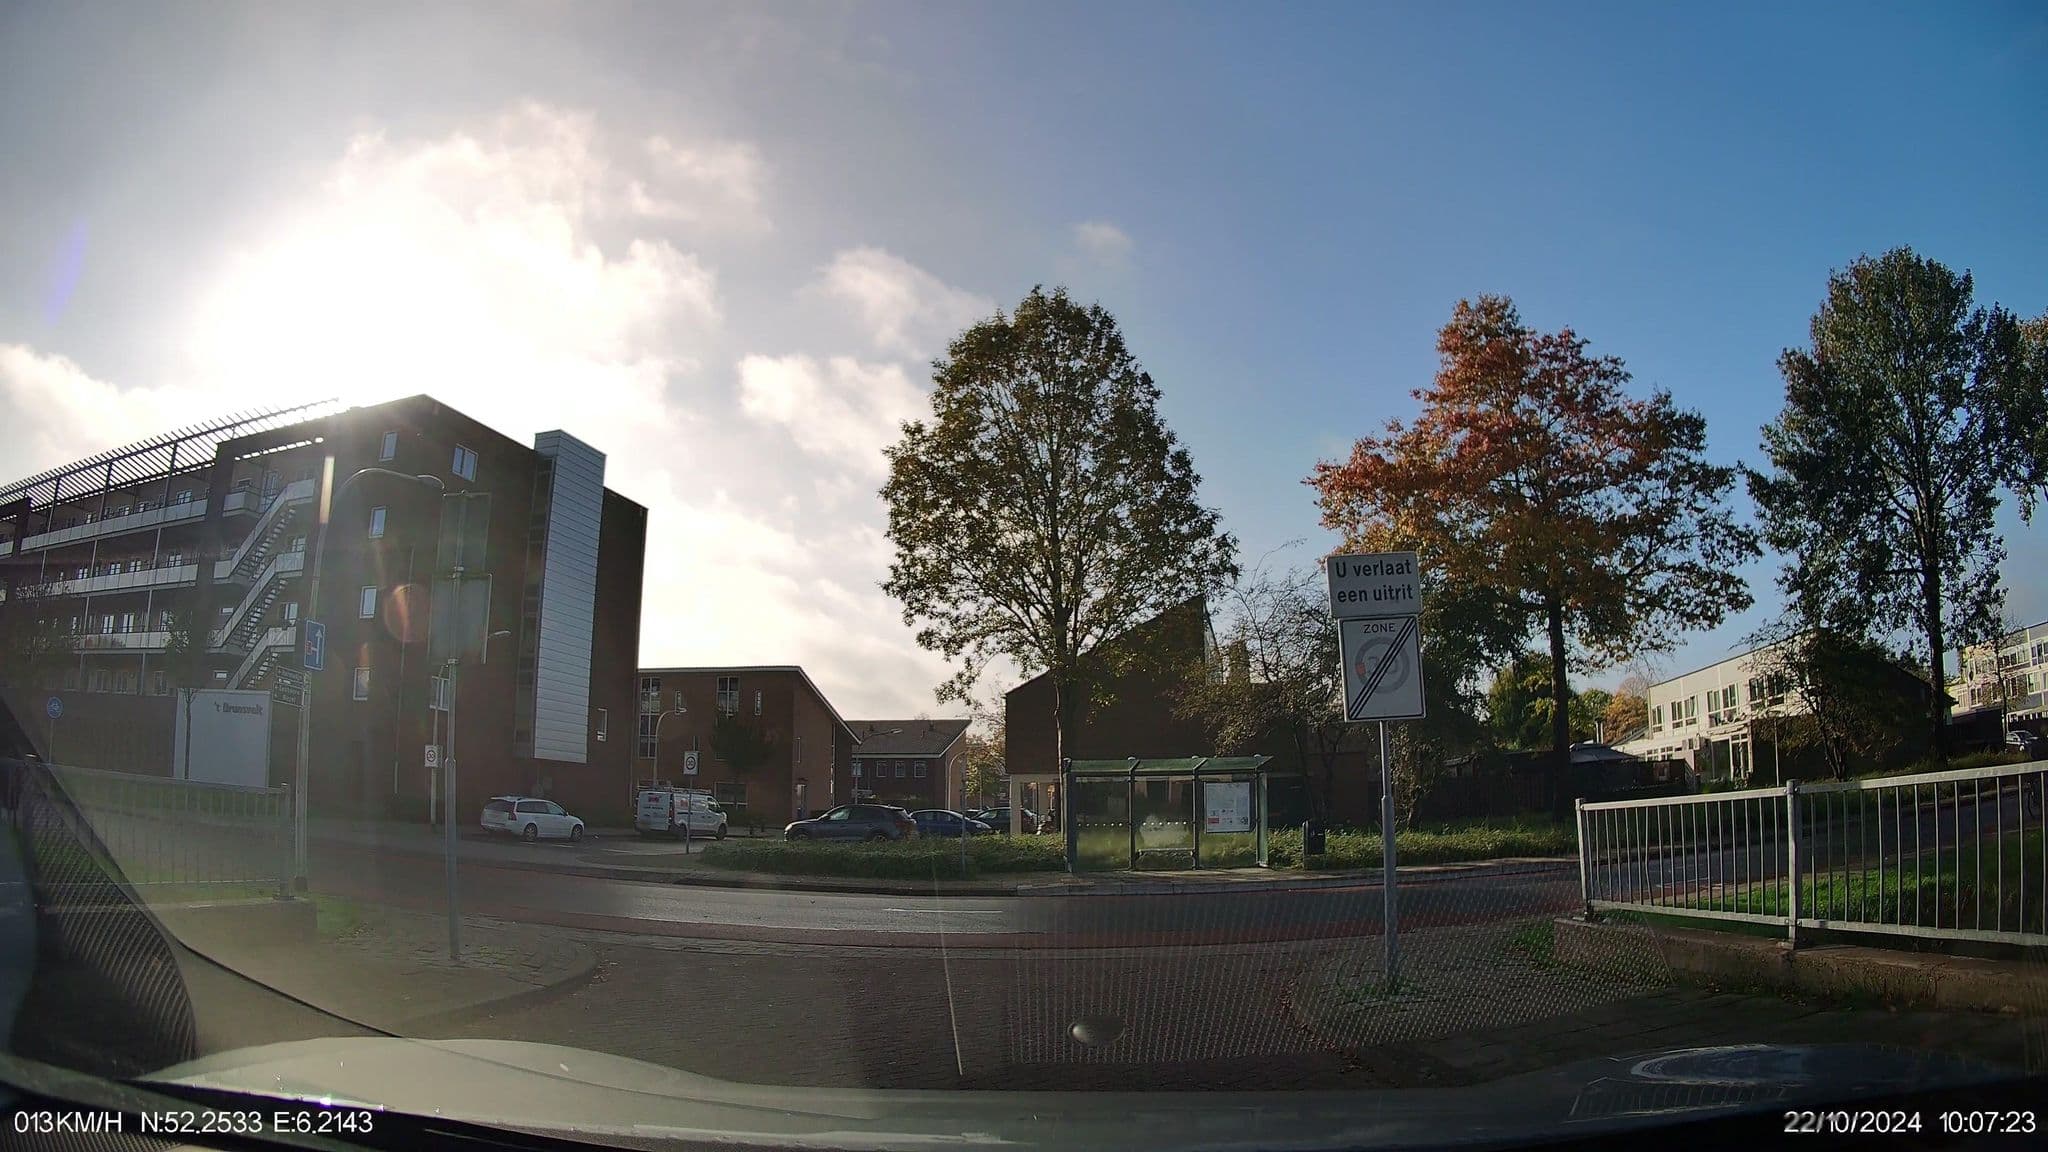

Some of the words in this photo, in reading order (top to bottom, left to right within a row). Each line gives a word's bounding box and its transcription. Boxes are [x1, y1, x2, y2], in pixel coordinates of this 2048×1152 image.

[1335, 561, 1347, 578] U
[1353, 559, 1412, 577] verlaat
[1337, 590, 1368, 603] een
[1373, 584, 1414, 601] uitrit
[1363, 622, 1396, 634] ZONE
